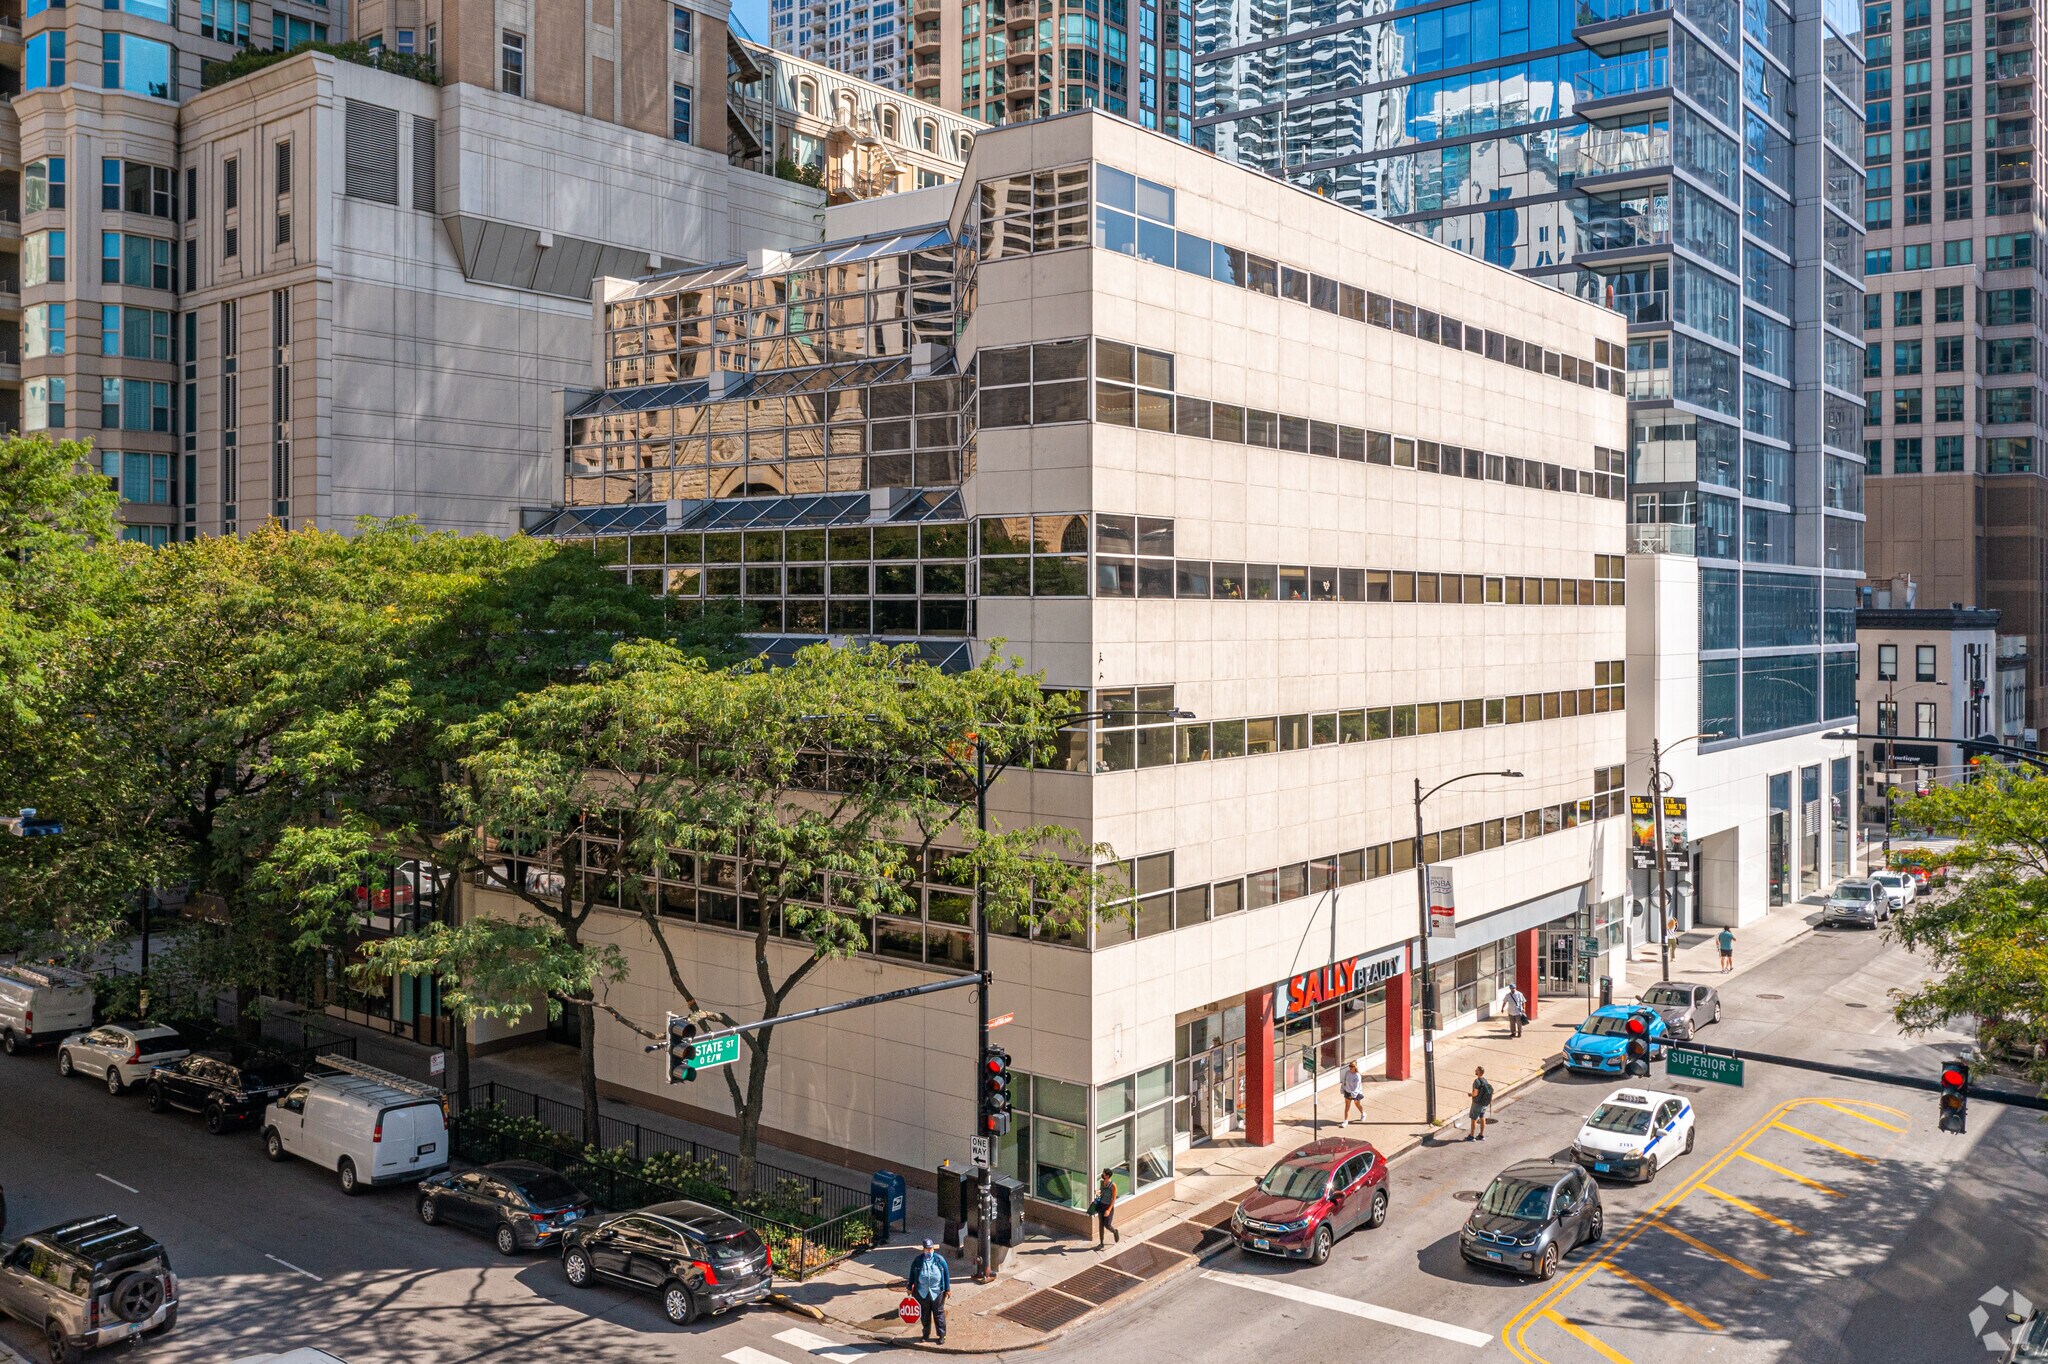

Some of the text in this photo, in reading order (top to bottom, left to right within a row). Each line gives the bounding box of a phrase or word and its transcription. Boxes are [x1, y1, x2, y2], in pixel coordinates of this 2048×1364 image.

[1431, 879, 1451, 888] RNBA
[1288, 955, 1401, 1013] SALLY BEAUTY
[695, 1039, 735, 1057] STATE ST
[706, 1053, 722, 1064] E/W
[1671, 1052, 1740, 1072] SUPERIOR ST
[1691, 1067, 1719, 1080] 732 N
[972, 1137, 987, 1148] ONE
[972, 1146, 987, 1156] WAY
[899, 1304, 920, 1317] STOP
